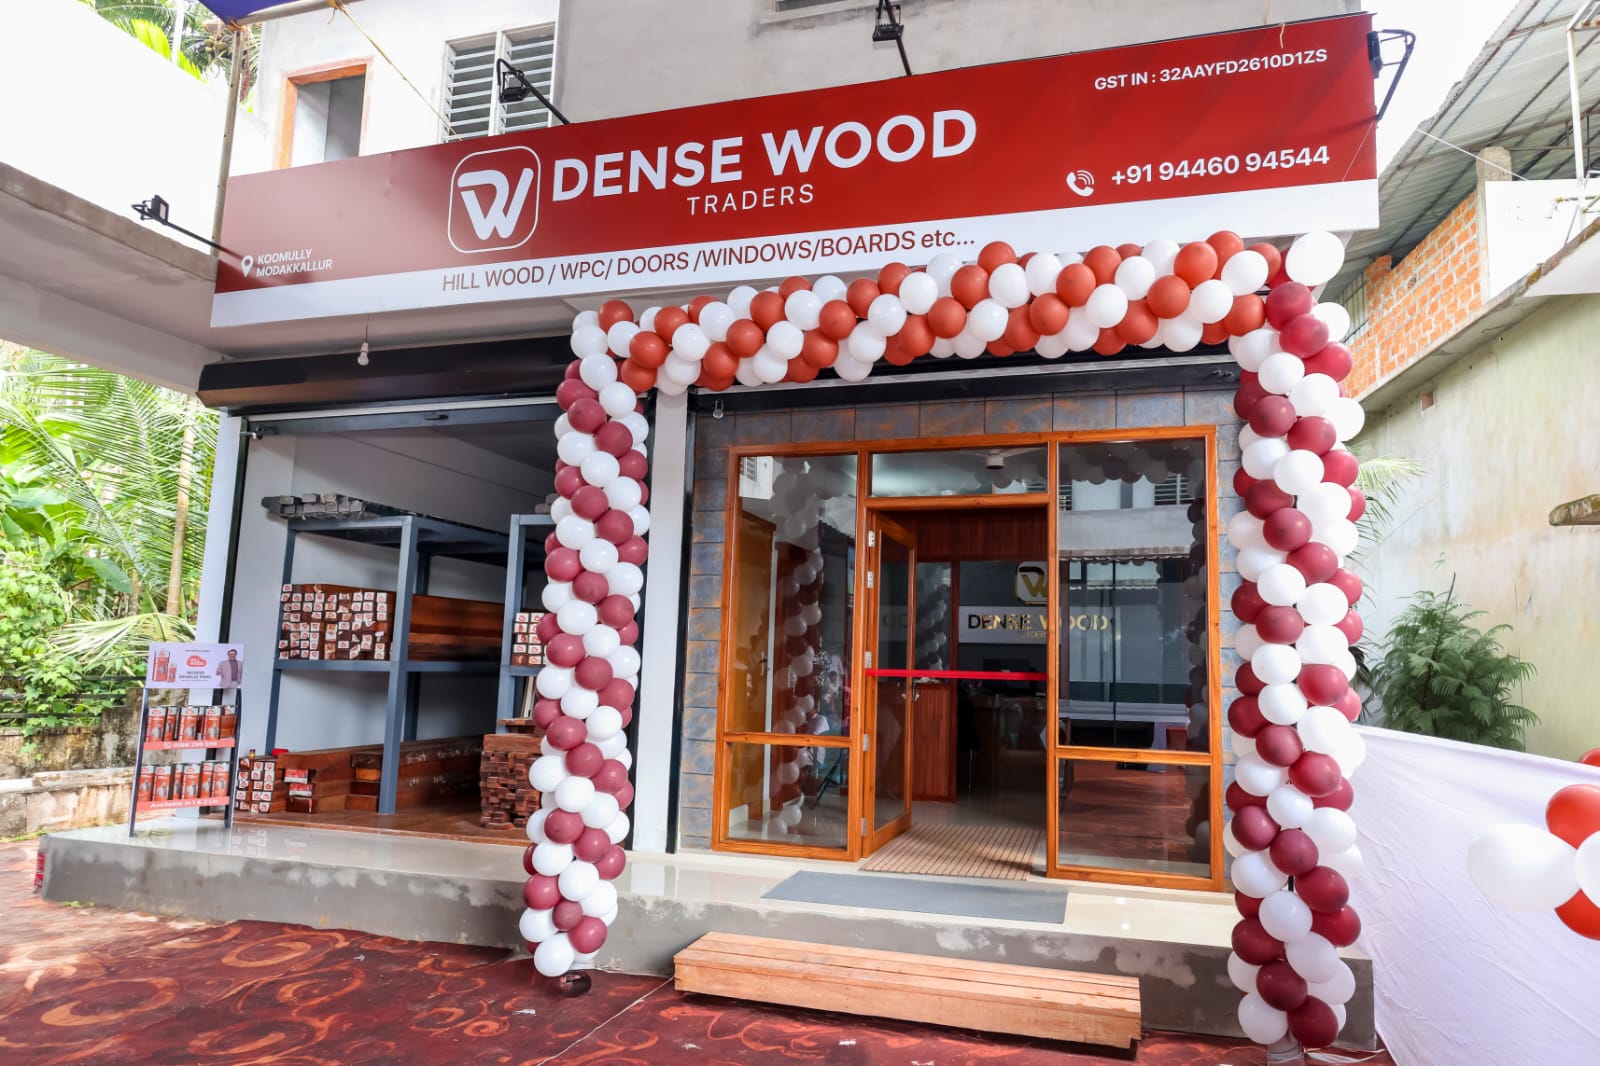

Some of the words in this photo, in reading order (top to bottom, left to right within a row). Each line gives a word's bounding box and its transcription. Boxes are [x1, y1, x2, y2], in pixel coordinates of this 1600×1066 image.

[1095, 73, 1127, 90] GST
[1131, 72, 1149, 86] IN
[552, 136, 744, 202] DENSE
[761, 109, 977, 177] WOOD
[1111, 164, 1153, 186] +91
[1159, 154, 1240, 182] 94460
[1245, 145, 1330, 172] 94544
[687, 183, 815, 216] TRADERS
[256, 258, 333, 278] MODAKKALLUR
[257, 248, 314, 264] KOOMULLY
[442, 272, 480, 292] HILL
[485, 265, 545, 288] WOOD
[617, 252, 690, 275] DOORS
[968, 614, 1032, 630] DENSE
